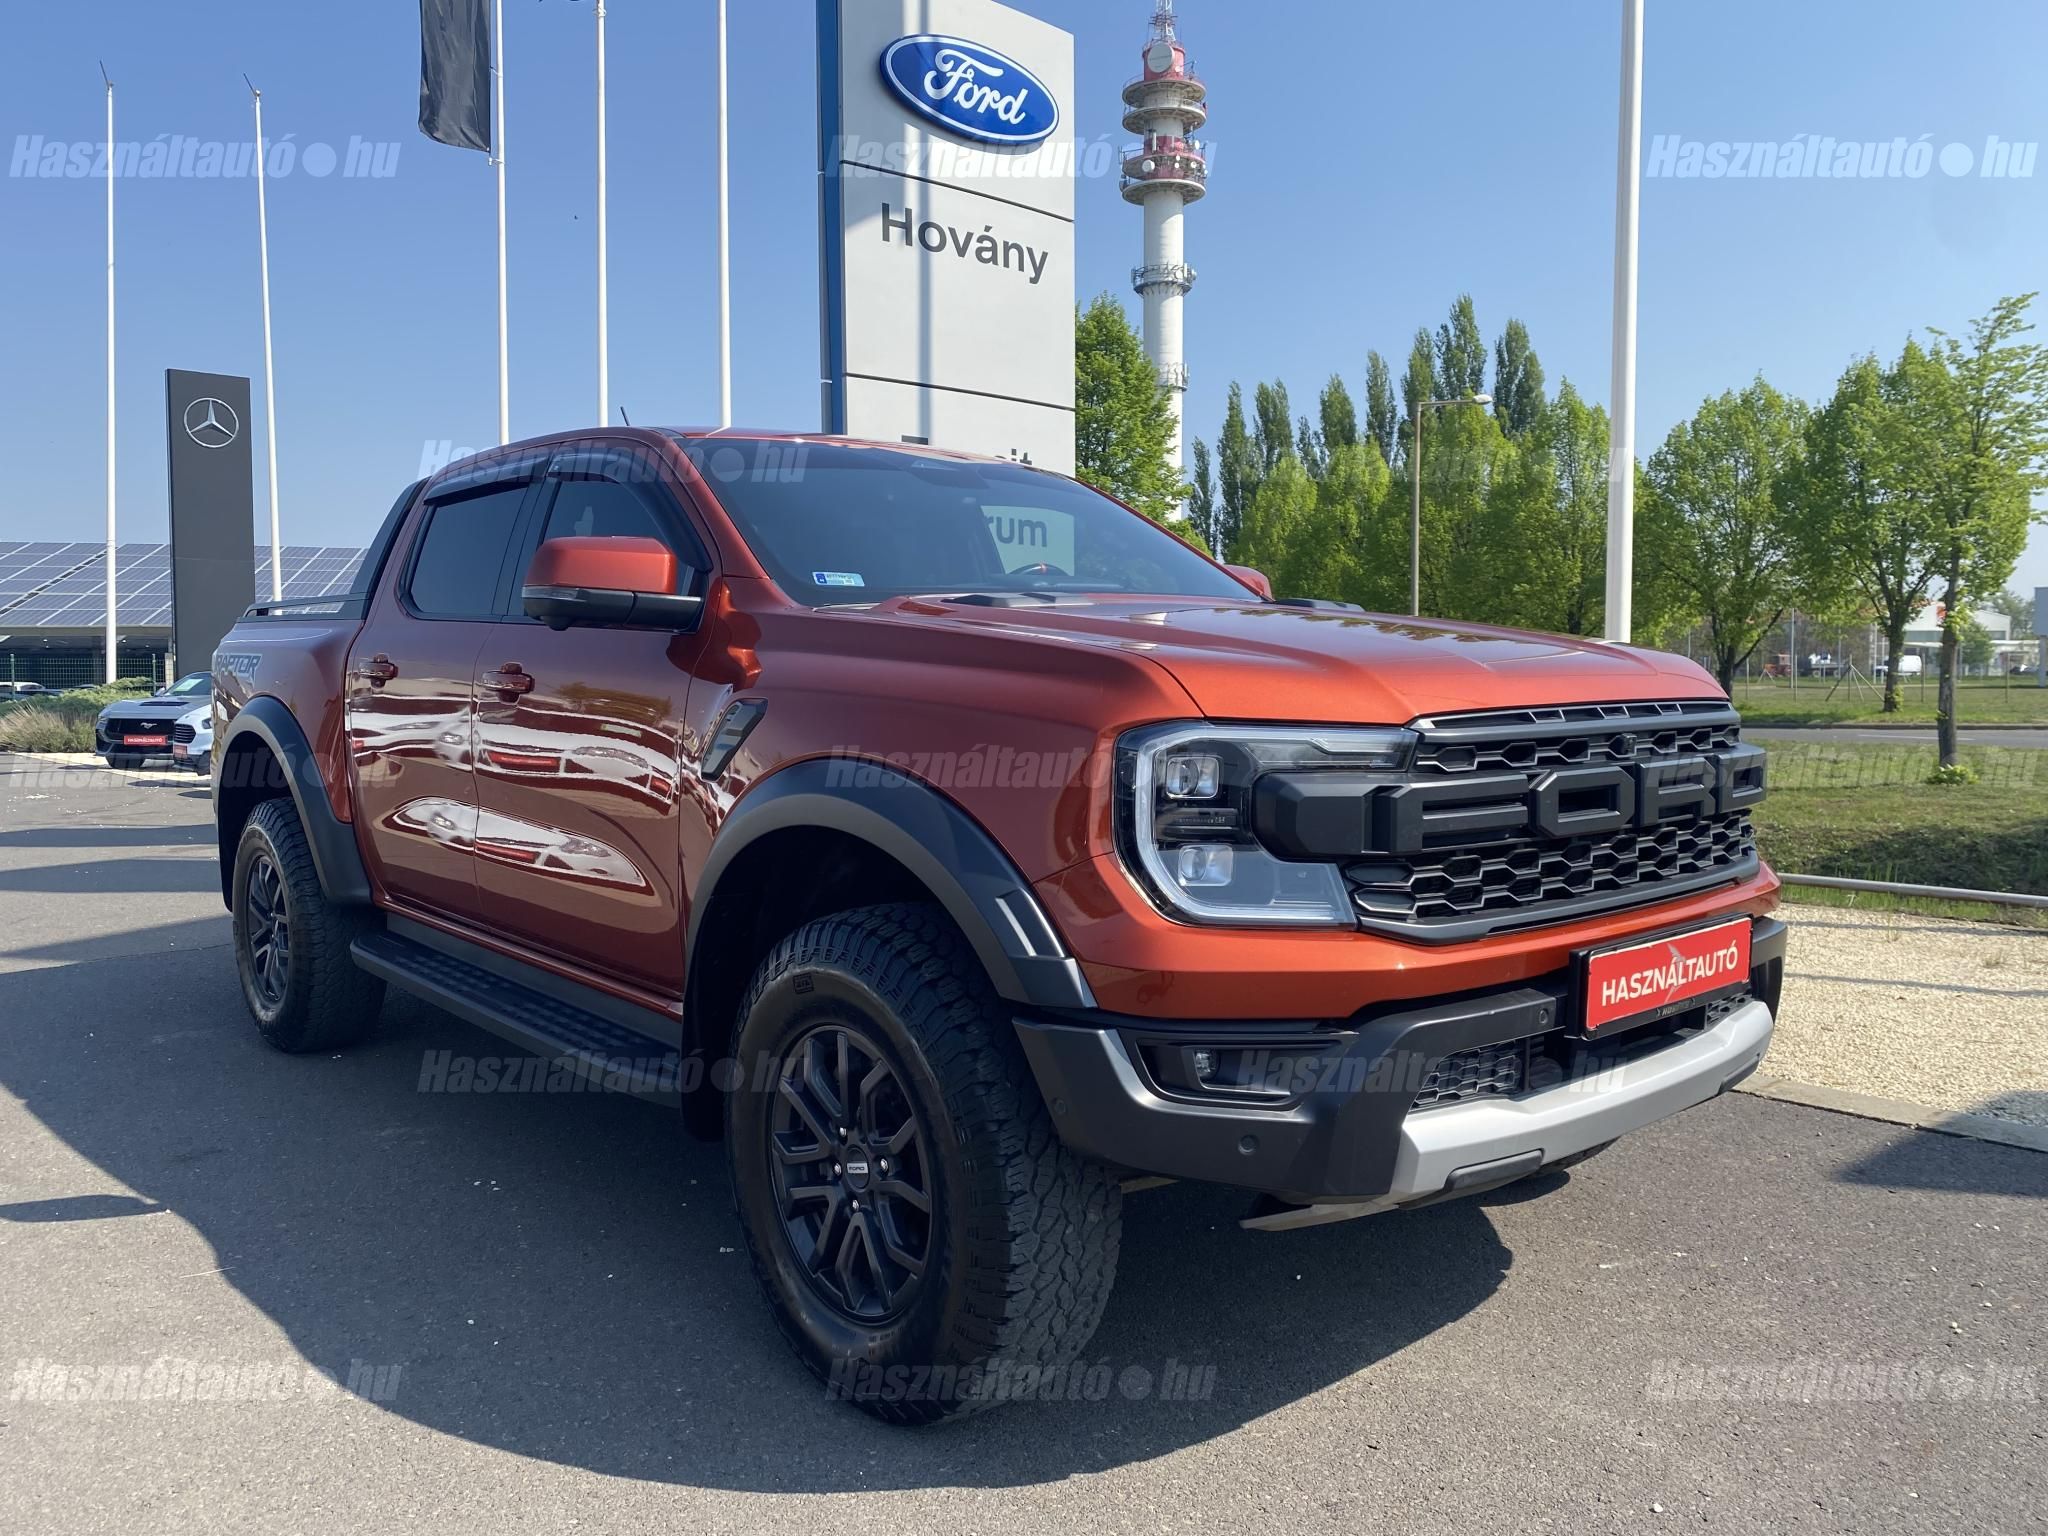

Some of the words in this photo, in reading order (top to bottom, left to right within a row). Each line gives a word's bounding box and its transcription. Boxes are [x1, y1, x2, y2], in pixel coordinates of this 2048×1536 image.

[923, 48, 1029, 125] Ford
[881, 202, 1048, 285] Hovány
[216, 654, 262, 687] RAPTOR
[1386, 743, 1767, 853] FORD
[1601, 939, 1739, 1007] HASZNÁLTAUTÓ
